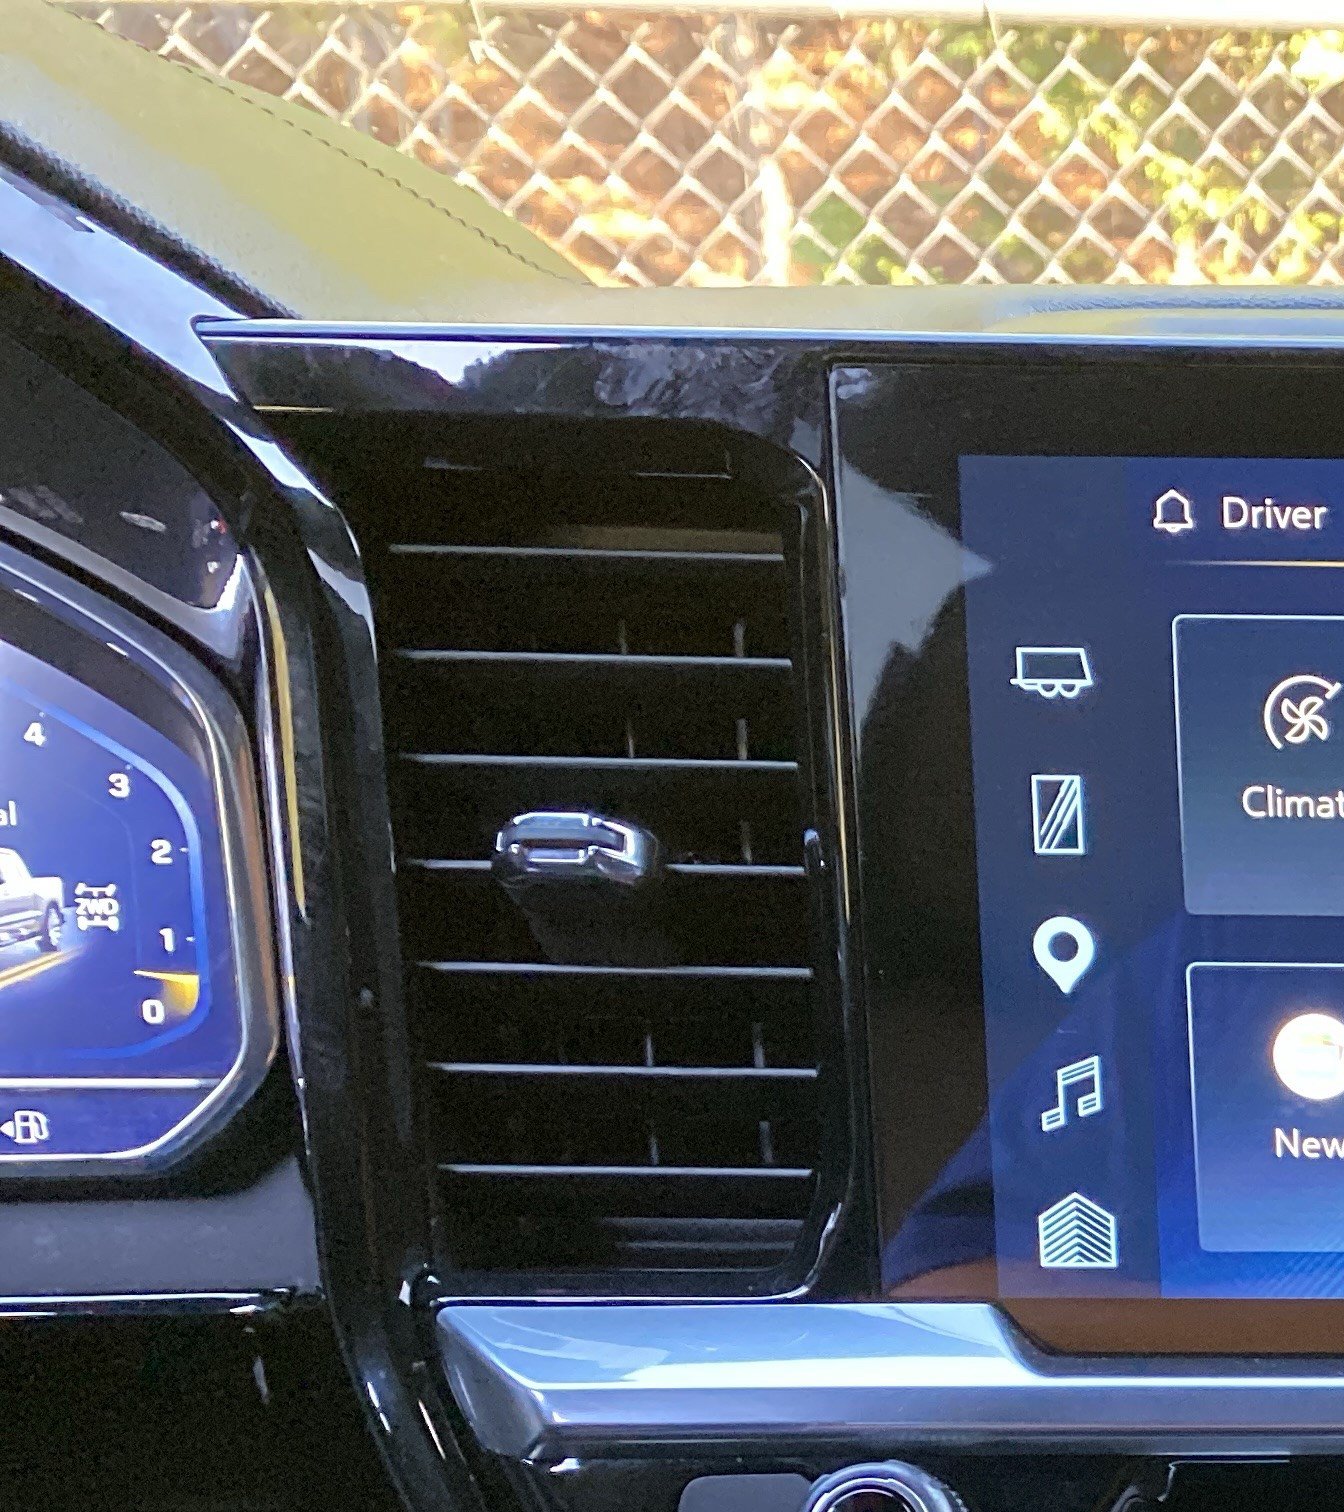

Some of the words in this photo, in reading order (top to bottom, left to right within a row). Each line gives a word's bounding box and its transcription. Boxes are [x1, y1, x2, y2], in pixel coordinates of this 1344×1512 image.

[1222, 496, 1327, 531] Driver
[24, 722, 46, 747] 4
[108, 774, 131, 798] 3
[151, 839, 173, 864] 2
[159, 928, 175, 952] 1
[142, 999, 165, 1024] 0
